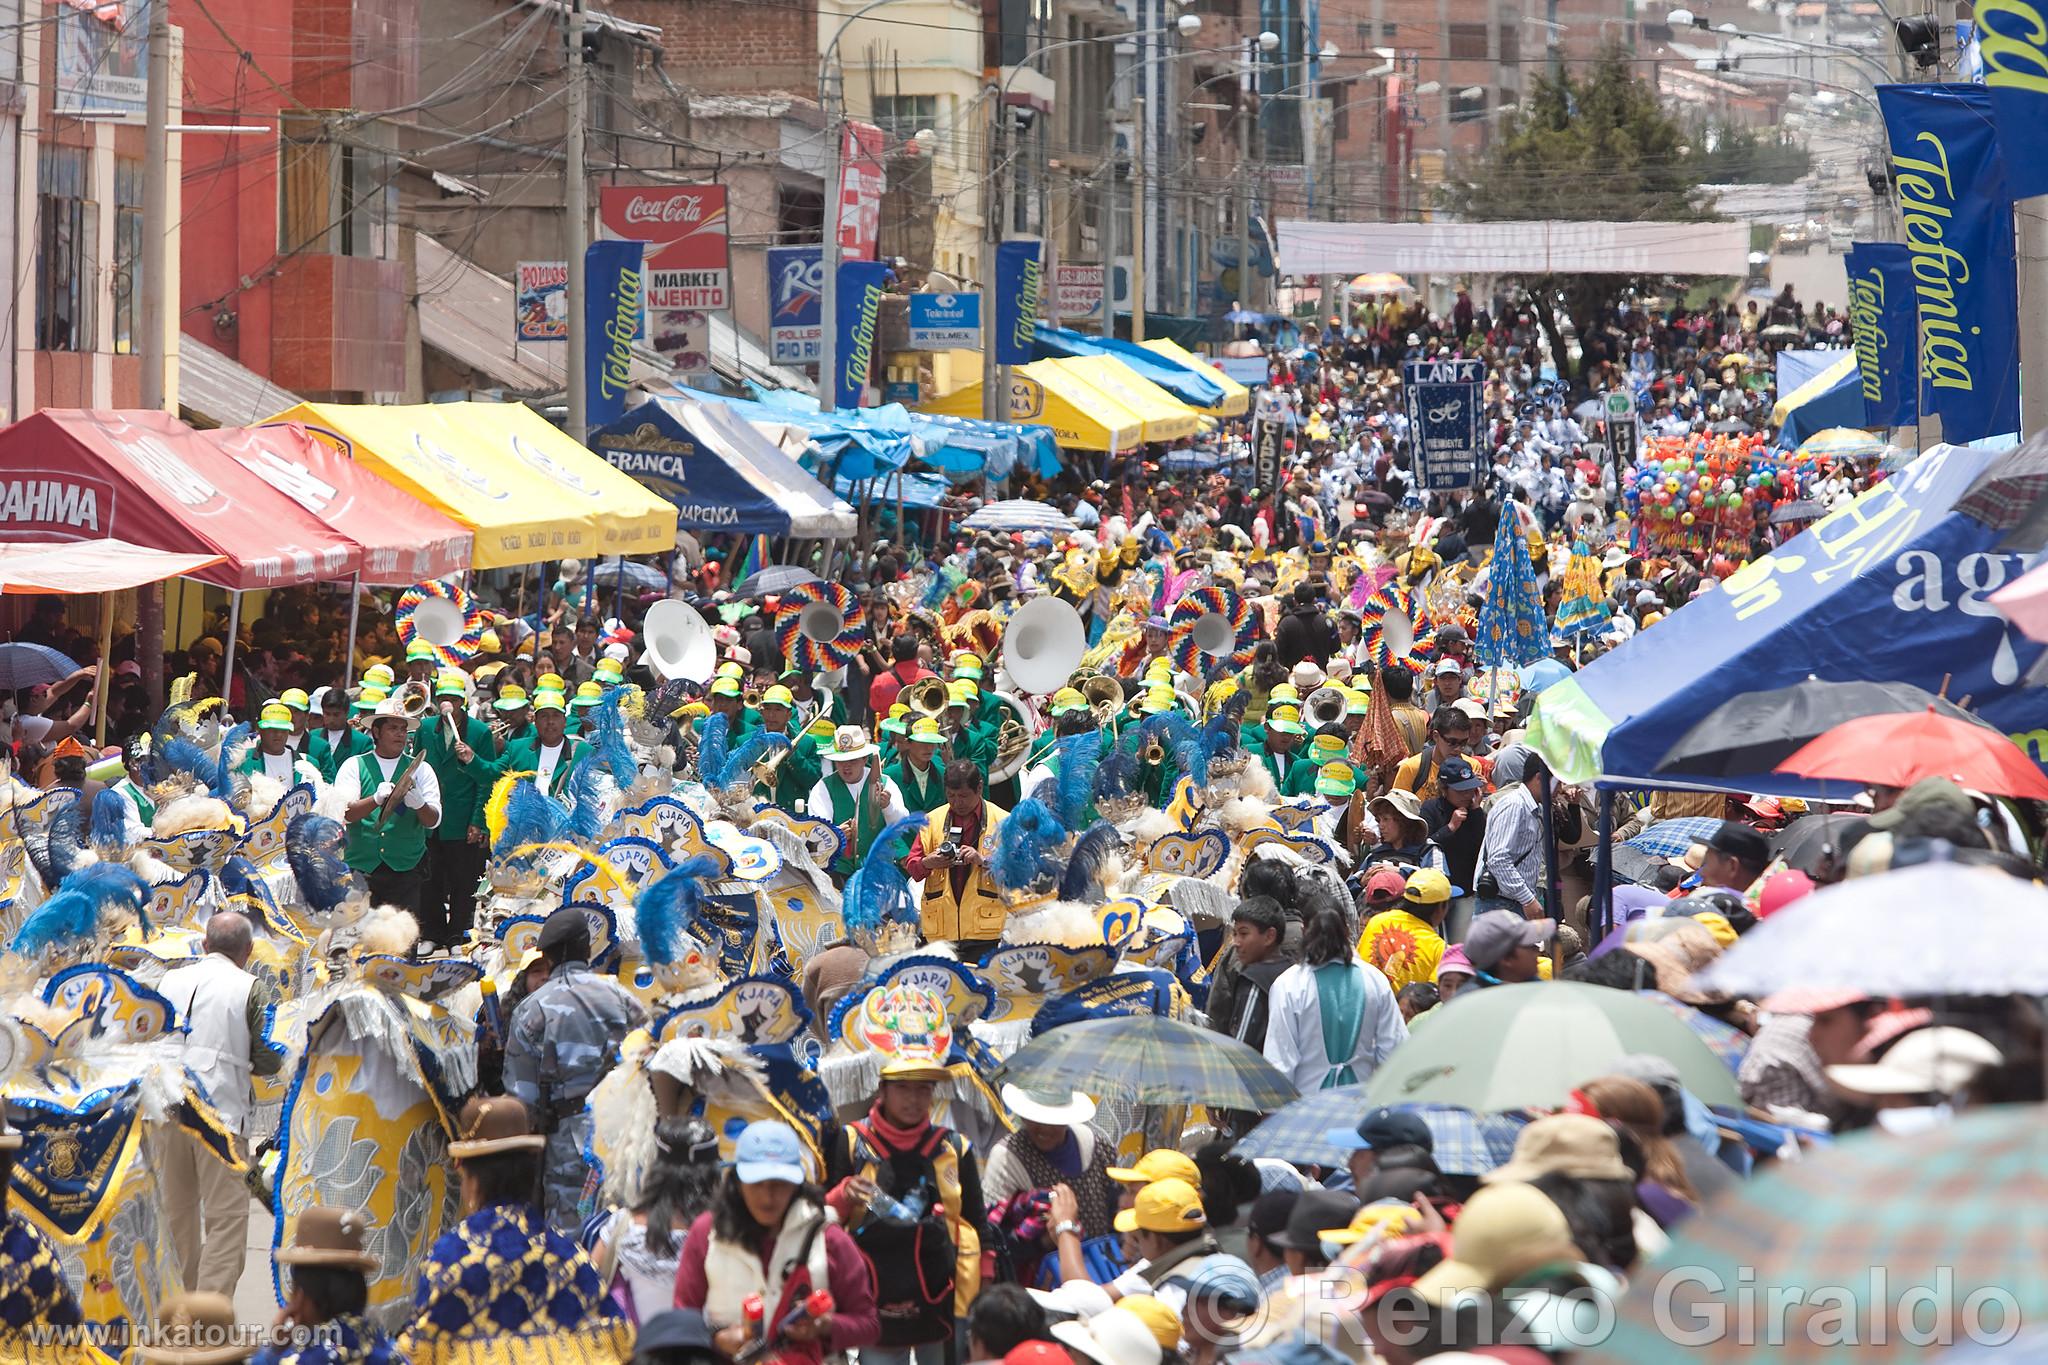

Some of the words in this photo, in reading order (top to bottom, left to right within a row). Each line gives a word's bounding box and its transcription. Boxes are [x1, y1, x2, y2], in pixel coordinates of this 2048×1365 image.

[625, 195, 703, 223] Coca-Cola
[654, 272, 719, 288] MARKET
[658, 809, 691, 830] KJAPIA
[612, 851, 650, 867] KJAPIA
[1003, 951, 1048, 968] KJAPIA
